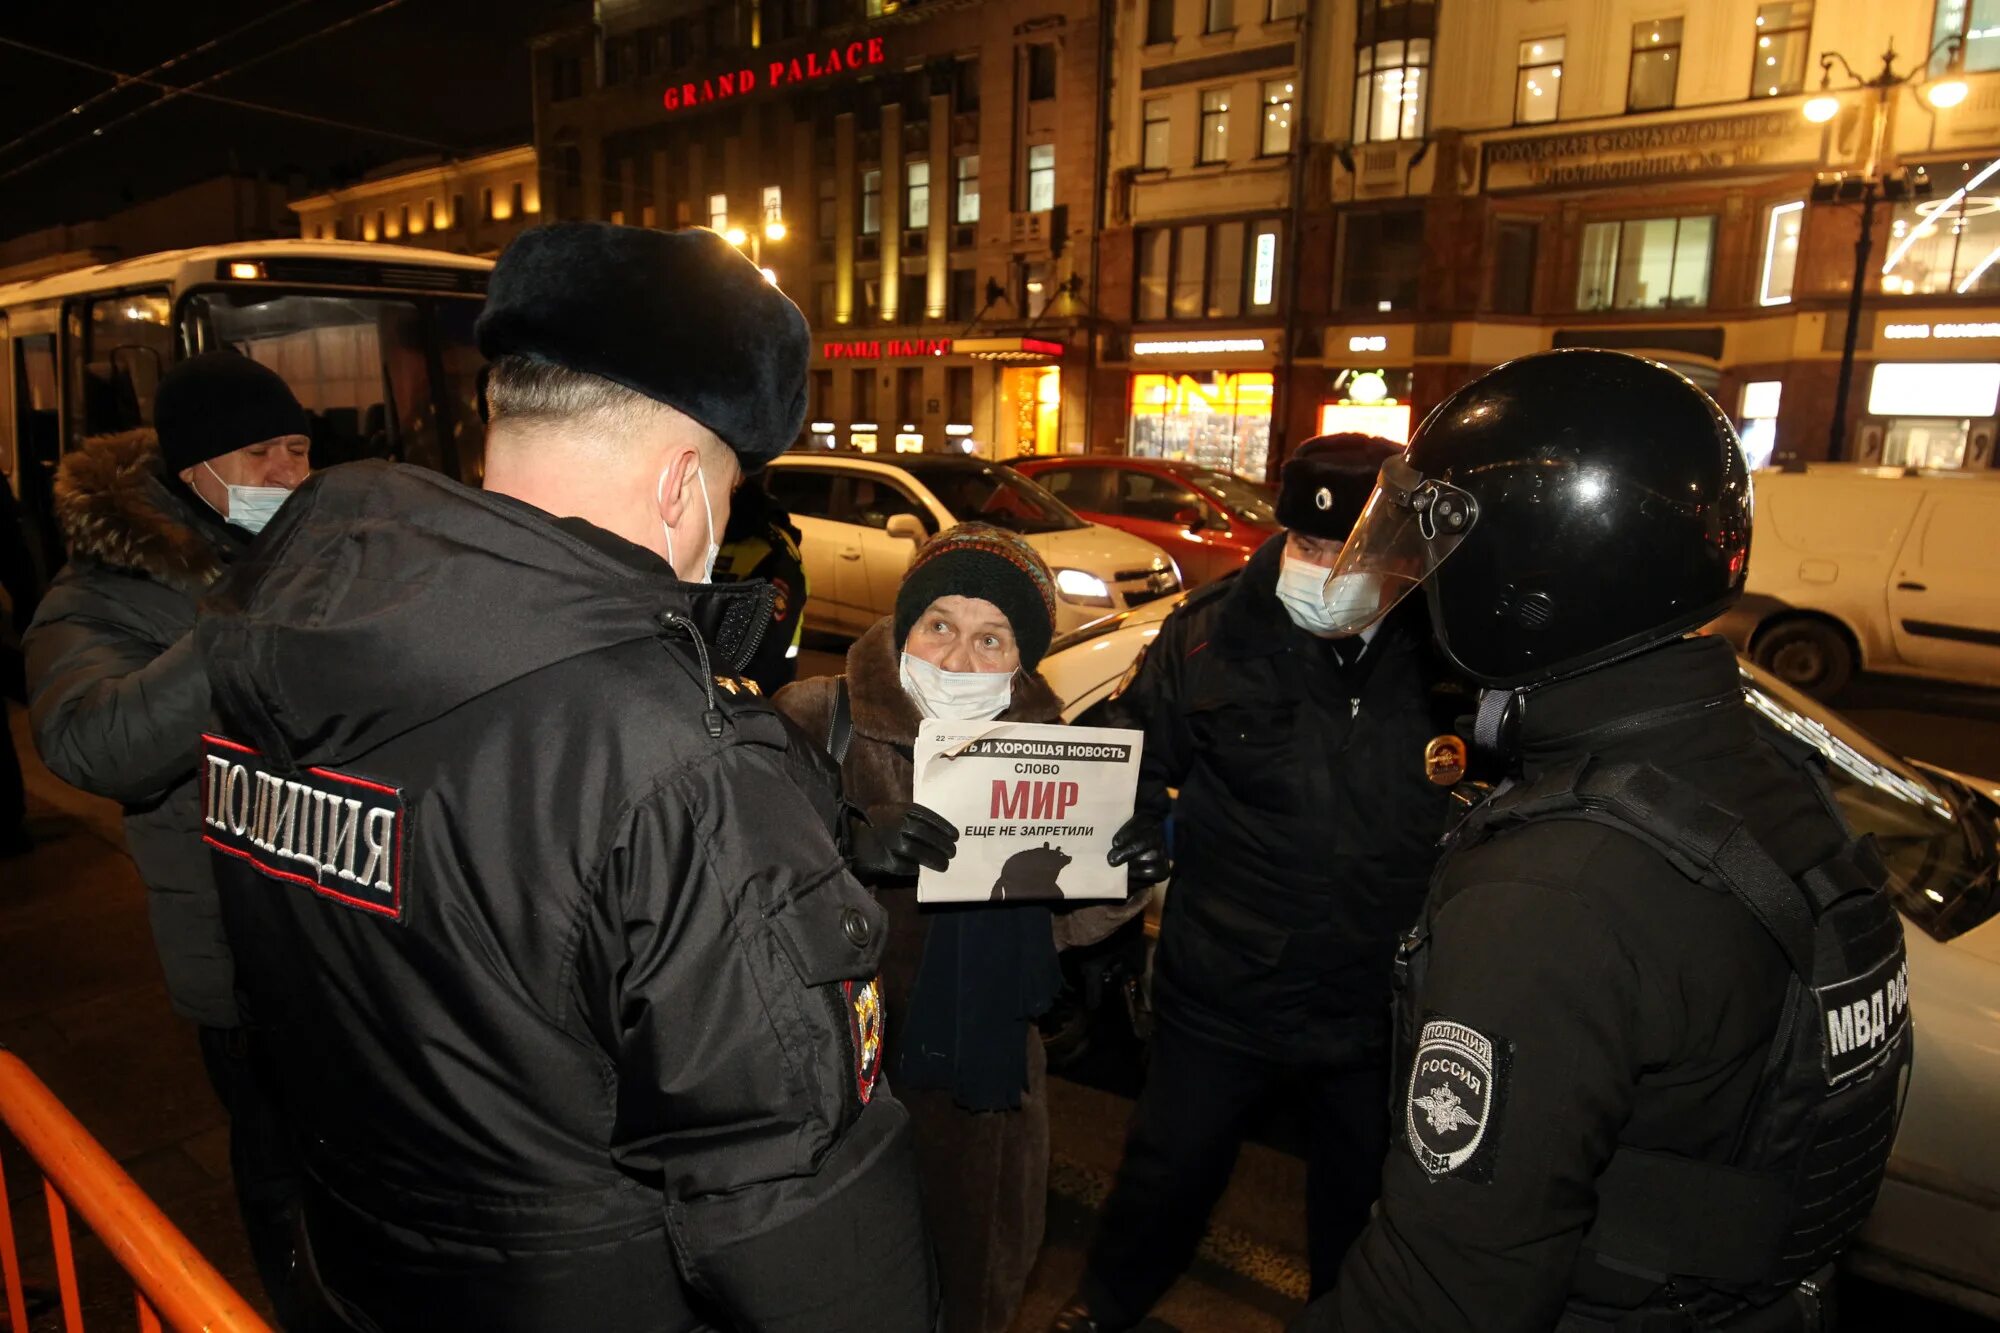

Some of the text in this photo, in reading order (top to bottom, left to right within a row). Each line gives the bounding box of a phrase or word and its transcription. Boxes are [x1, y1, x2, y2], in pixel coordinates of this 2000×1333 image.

[663, 36, 885, 112] GRAND PALACE
[823, 337, 952, 360] ГРАНД ПАЛАС
[981, 742, 991, 753] И
[995, 741, 1064, 757] ХОРОШАЯ
[1067, 745, 1126, 759] НОВОСТЬ
[1014, 762, 1060, 775] СЛОВО
[990, 779, 1079, 820] МИР
[205, 754, 396, 893] ПОЛИЦИЯ
[965, 825, 1094, 838] ЕЩЕ НЕ ЗАПРЕТИЛИ
[1827, 989, 1886, 1057] МВД
[1426, 1024, 1488, 1059] ПОЛИЦИЯ
[1421, 1058, 1481, 1096] РОССИЯ
